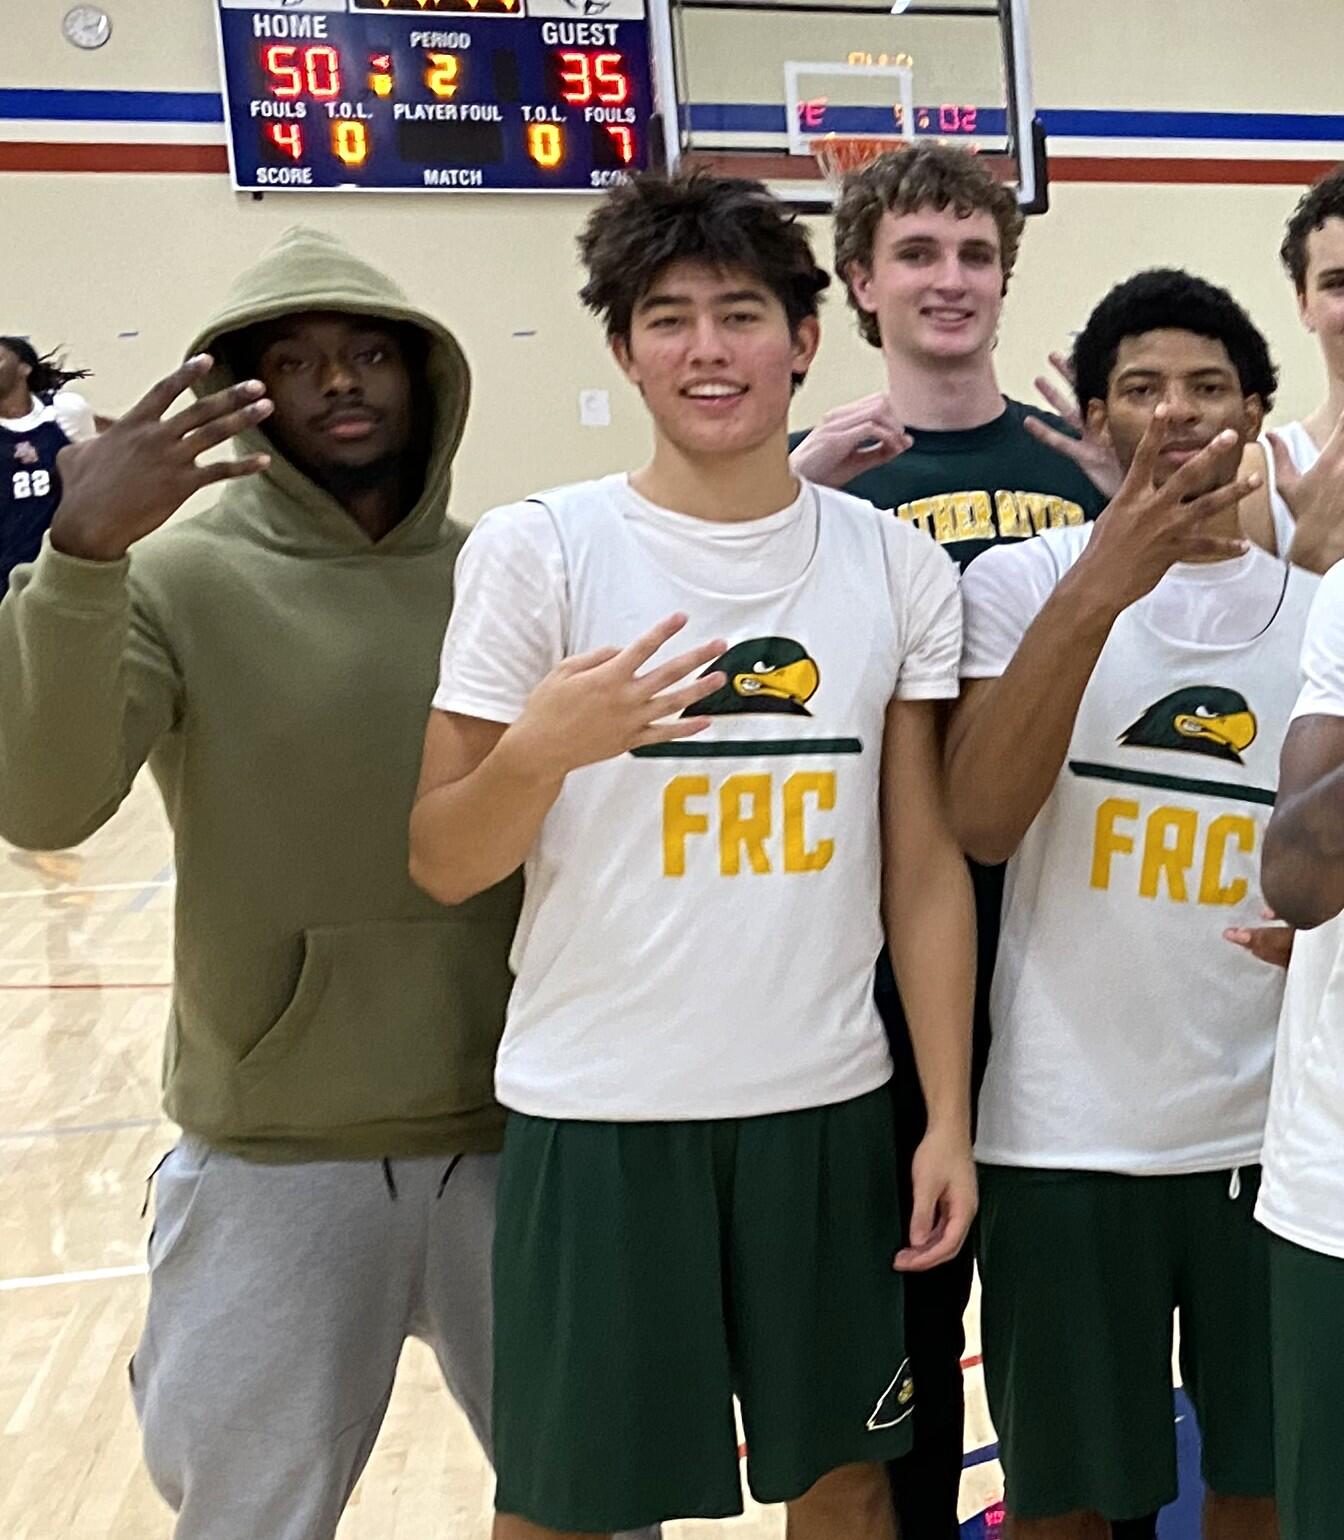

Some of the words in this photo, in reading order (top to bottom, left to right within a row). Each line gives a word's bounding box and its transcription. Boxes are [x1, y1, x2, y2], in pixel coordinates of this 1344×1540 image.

[252, 13, 328, 39] HOME
[541, 22, 620, 46] GUEST
[410, 31, 471, 49] PERIOD
[266, 45, 340, 97] 50
[427, 52, 458, 97] 2
[560, 52, 627, 102] 35
[250, 101, 307, 118] FOULS
[325, 102, 373, 119] T.O.L.
[393, 103, 458, 120] PLAYER
[459, 104, 503, 121] FOUL
[521, 106, 567, 122] T.O.L.
[584, 107, 637, 122] FOULS
[271, 122, 302, 160] 4
[335, 120, 367, 164] 0
[530, 123, 562, 167] 0
[606, 126, 632, 163] 7
[256, 167, 313, 185] SCORE
[423, 169, 483, 186] MATCH
[591, 170, 629, 187] SCO
[12, 469, 50, 499] 22
[662, 771, 836, 877] FRC
[1090, 797, 1256, 906] FRC
